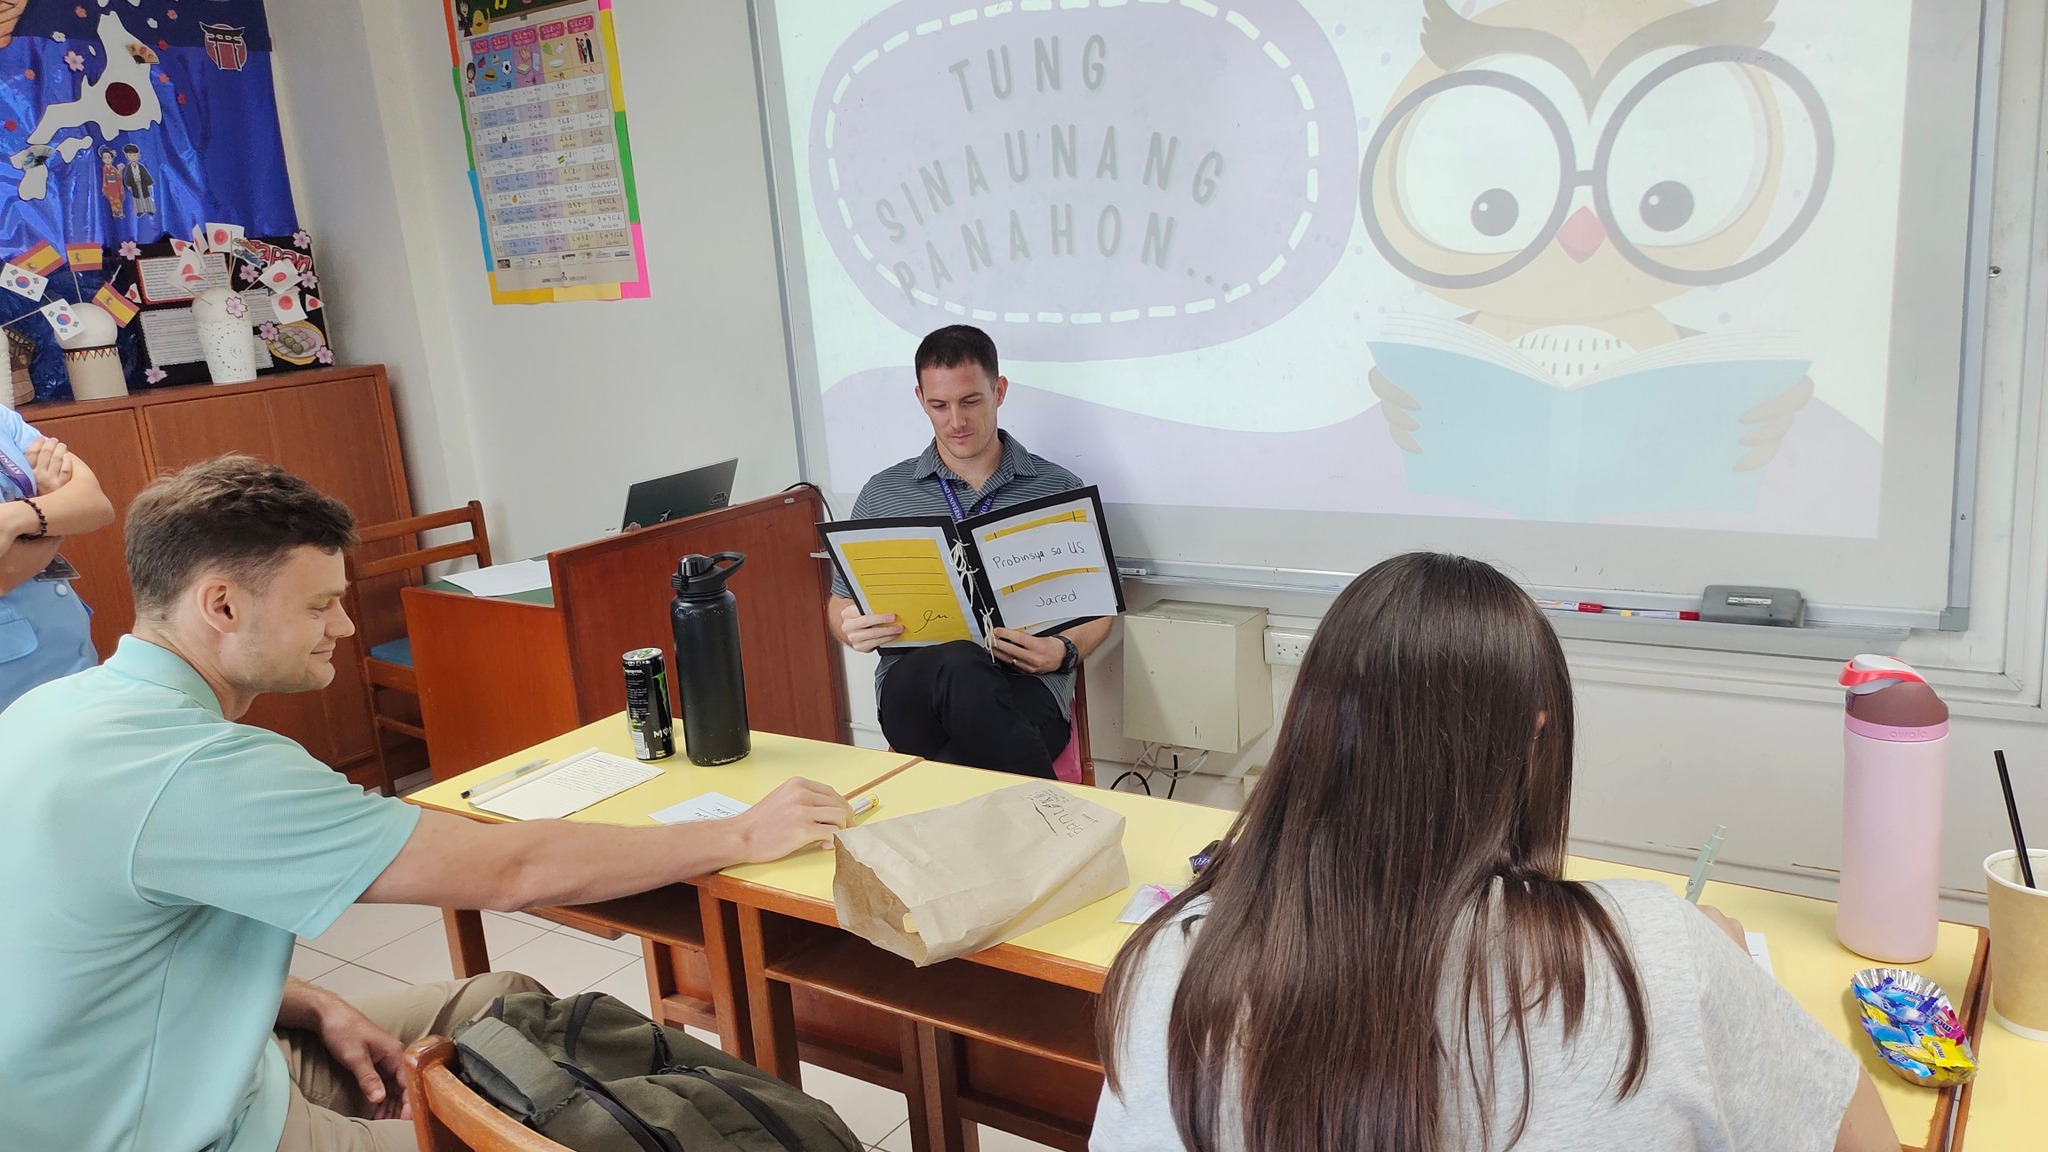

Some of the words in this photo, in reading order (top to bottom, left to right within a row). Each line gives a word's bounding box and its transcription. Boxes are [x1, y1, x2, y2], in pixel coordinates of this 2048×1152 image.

[949, 34, 1106, 113] TUNG
[876, 124, 1224, 244] SINAUNANG
[250, 241, 312, 273] apan
[894, 203, 1231, 305] PANAHON...
[992, 550, 1046, 570] Probinsya
[1050, 546, 1062, 556] sa
[1067, 540, 1086, 555] US
[1035, 588, 1078, 608] Jared
[1888, 728, 1929, 740] owala
